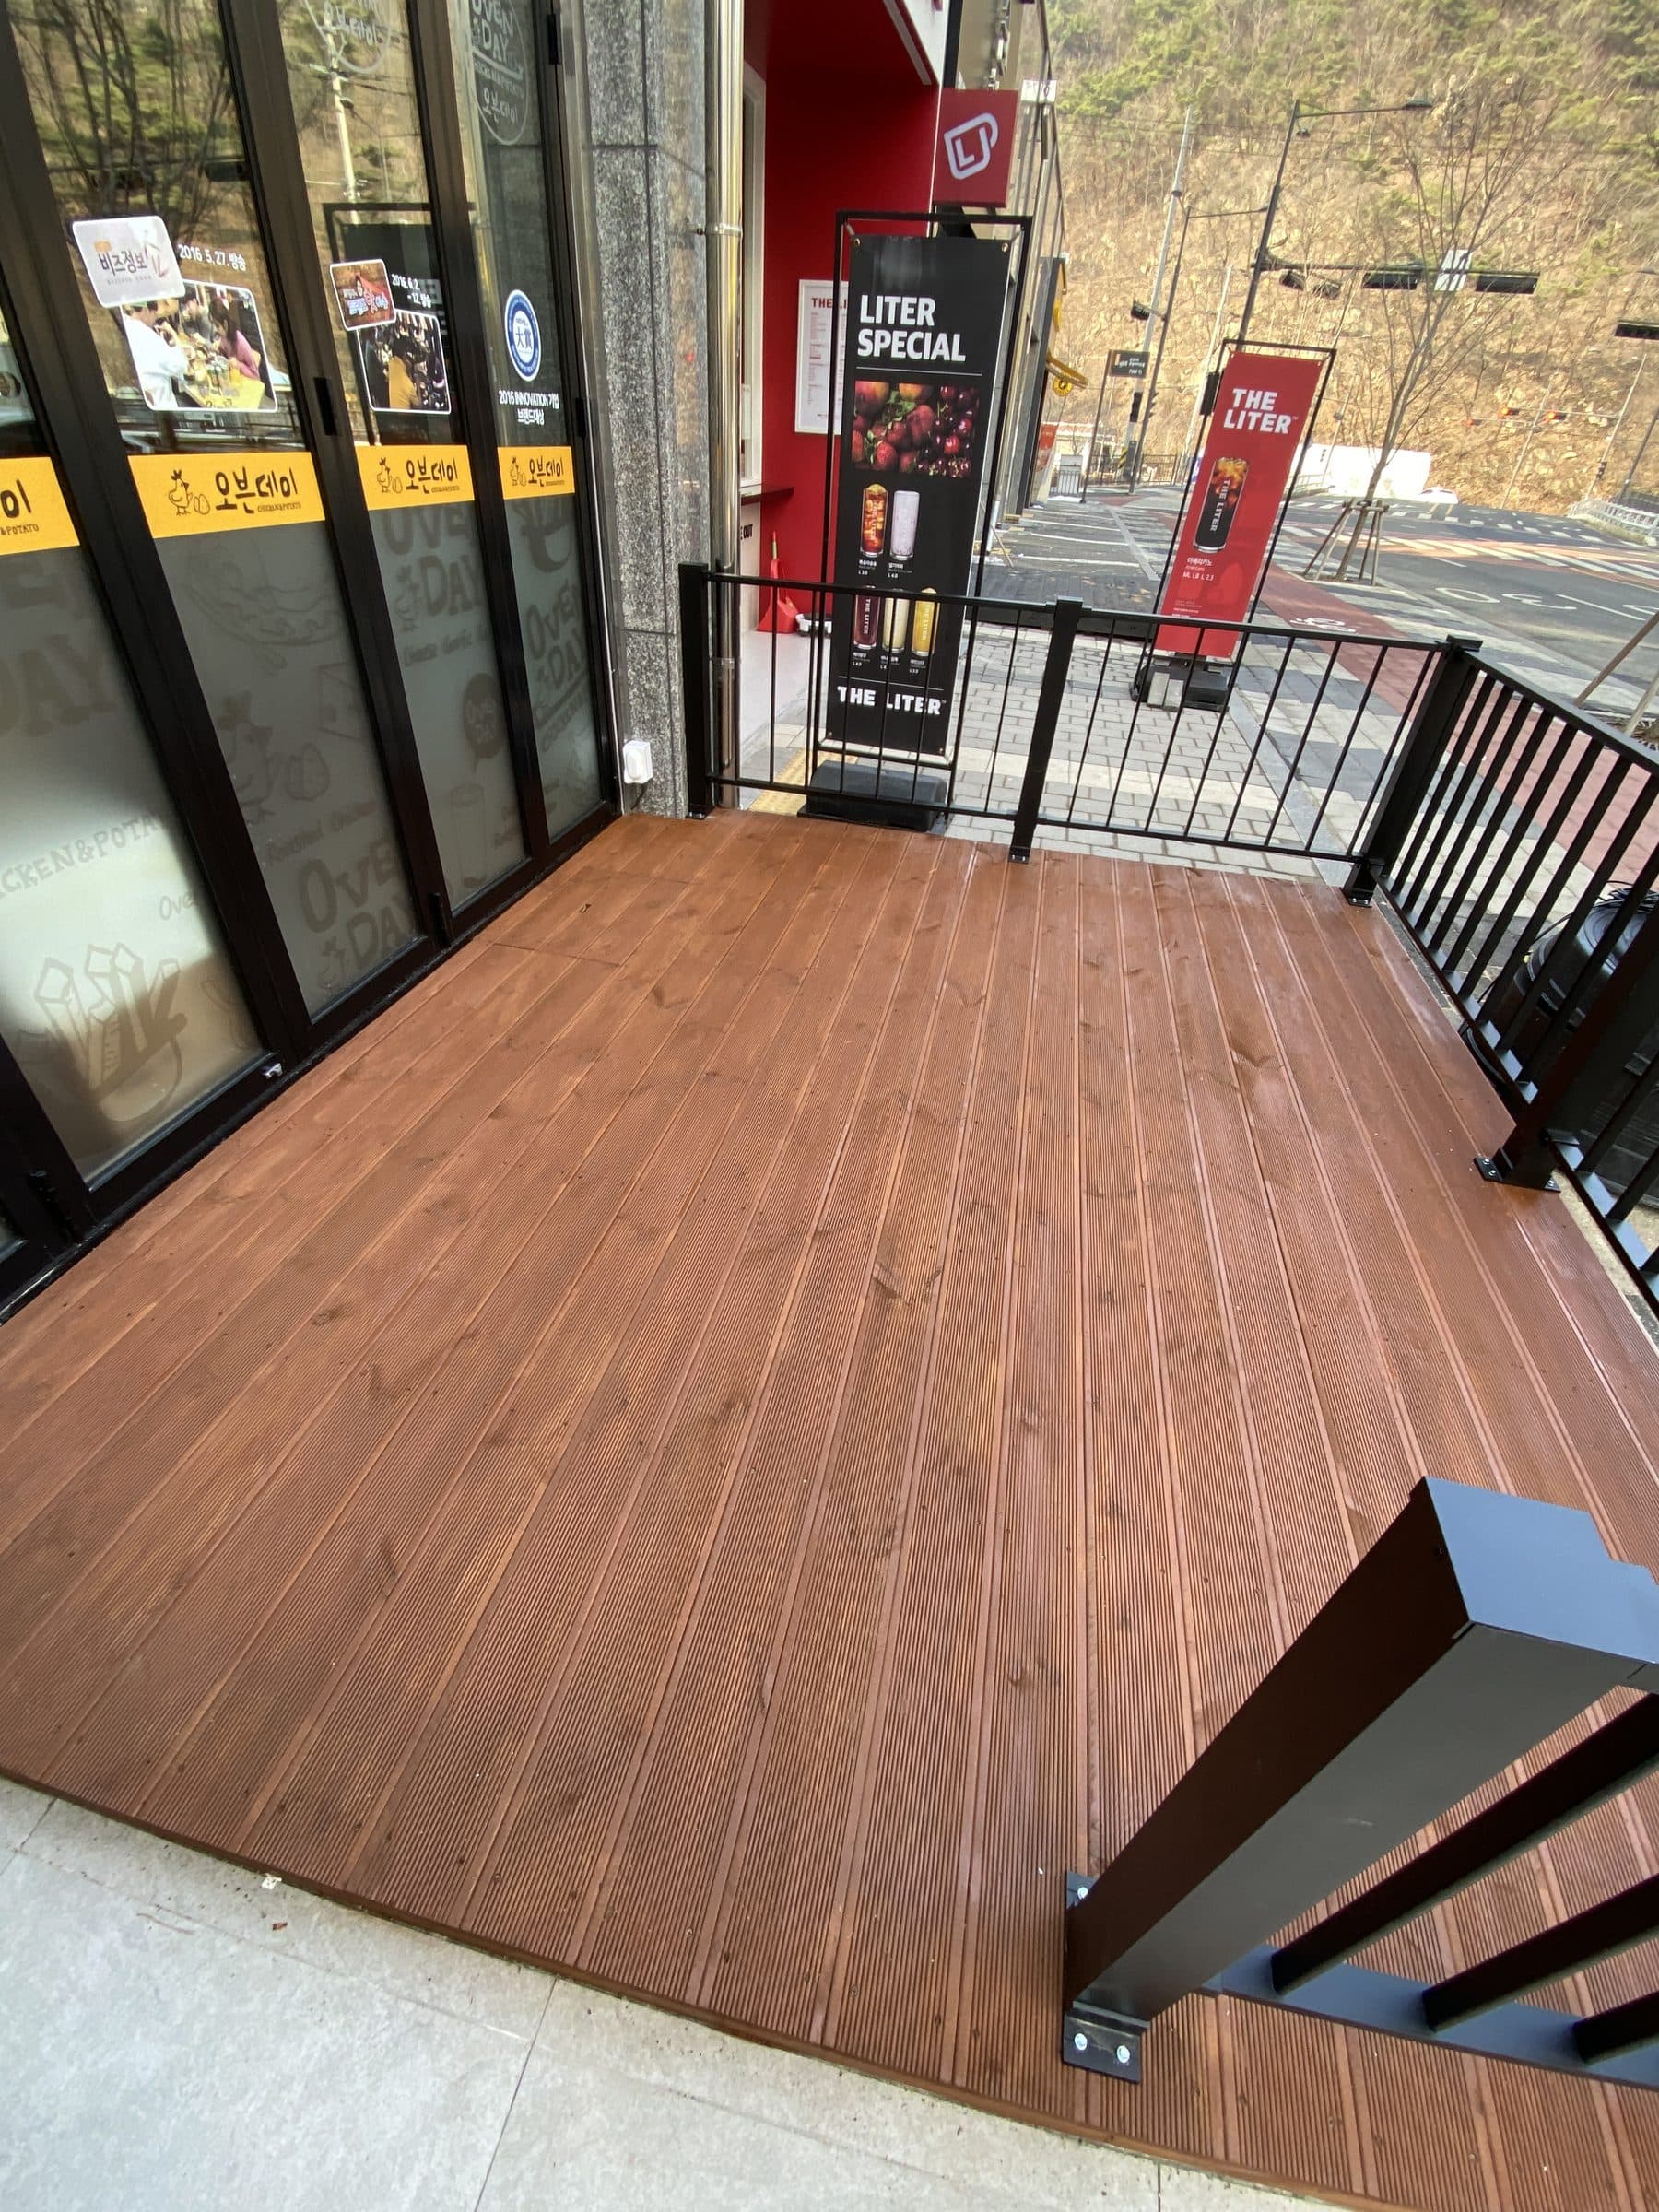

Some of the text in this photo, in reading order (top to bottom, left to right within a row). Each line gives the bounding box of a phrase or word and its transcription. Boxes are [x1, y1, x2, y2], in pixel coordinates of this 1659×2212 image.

[98, 250, 147, 276] 비즈정보
[811, 297, 833, 309] THE
[859, 294, 936, 326] LITER
[857, 328, 966, 362] SPECIAL
[499, 389, 514, 405] 2016
[514, 390, 549, 407] INNOVATION
[1232, 387, 1277, 411] THE
[516, 408, 545, 426] 브랜드대상
[1223, 409, 1292, 435] LITER
[405, 455, 458, 494] 오븐데이
[528, 455, 564, 487] 오븐데이
[215, 466, 299, 514] 오븐데이
[1210, 478, 1230, 533] THE LITER
[837, 686, 942, 715] THE LITER
